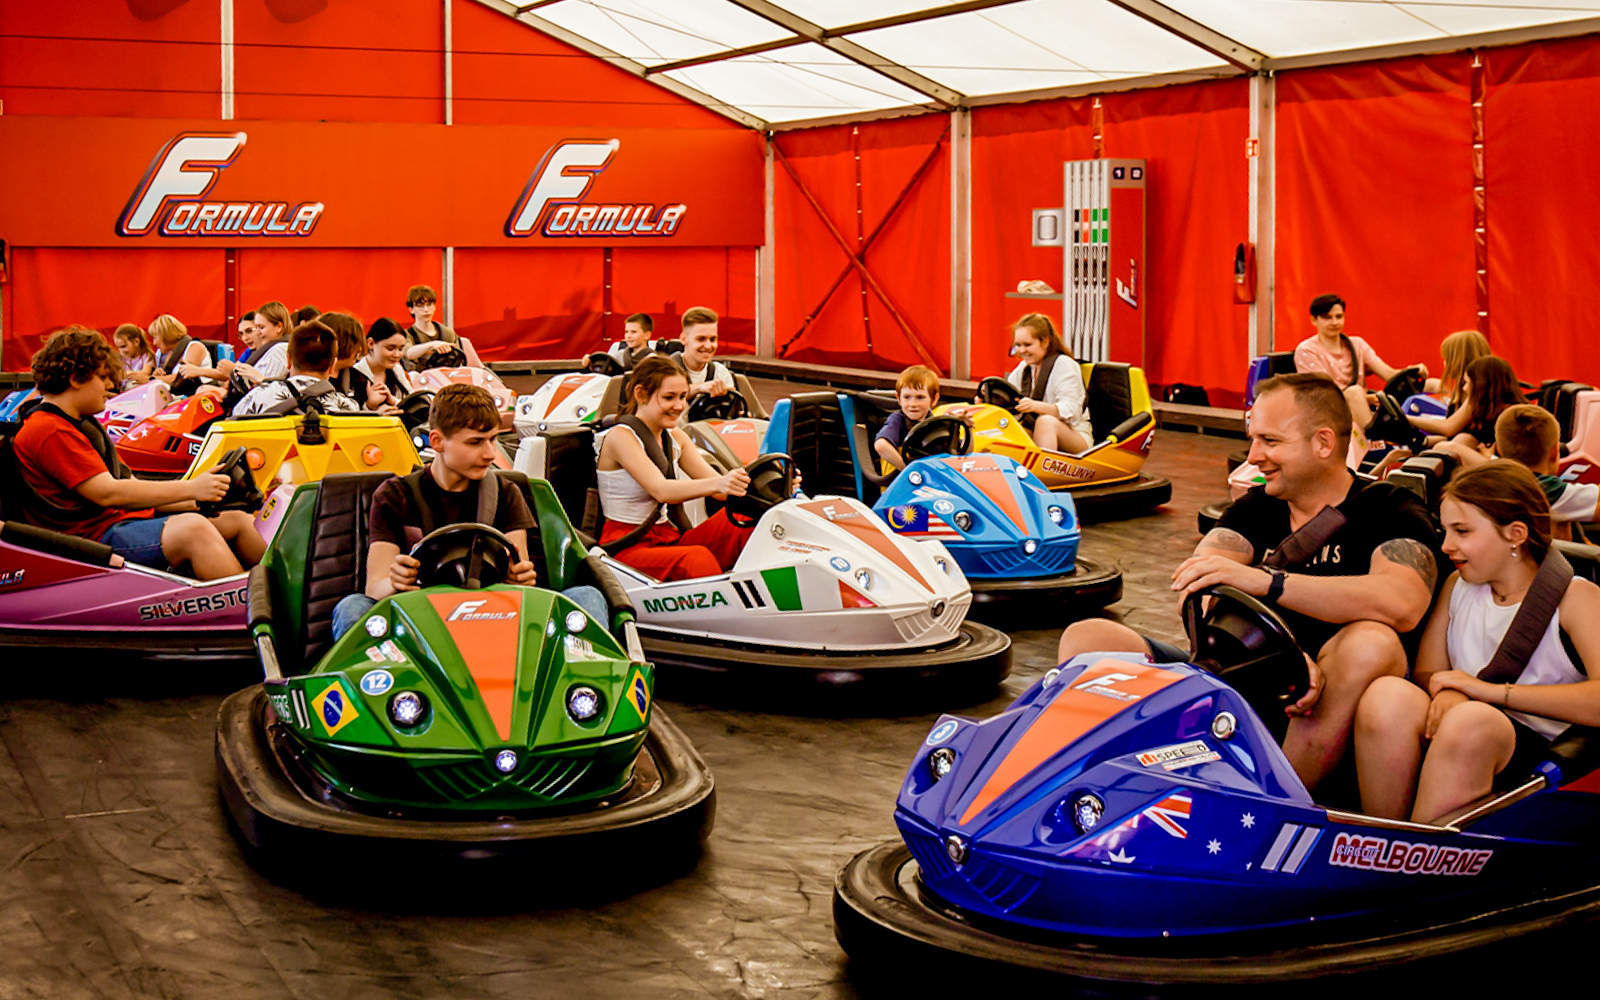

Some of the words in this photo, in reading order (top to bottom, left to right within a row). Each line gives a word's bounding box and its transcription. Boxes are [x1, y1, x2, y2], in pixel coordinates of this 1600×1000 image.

[115, 132, 324, 237] FORMULA
[504, 138, 687, 237] FORMULA
[1041, 457, 1096, 481] CATALUNYA
[444, 599, 518, 622] FORMULA
[642, 591, 729, 614] MONZA
[366, 673, 388, 690] 12
[1329, 832, 1493, 876] MELBOURNE
